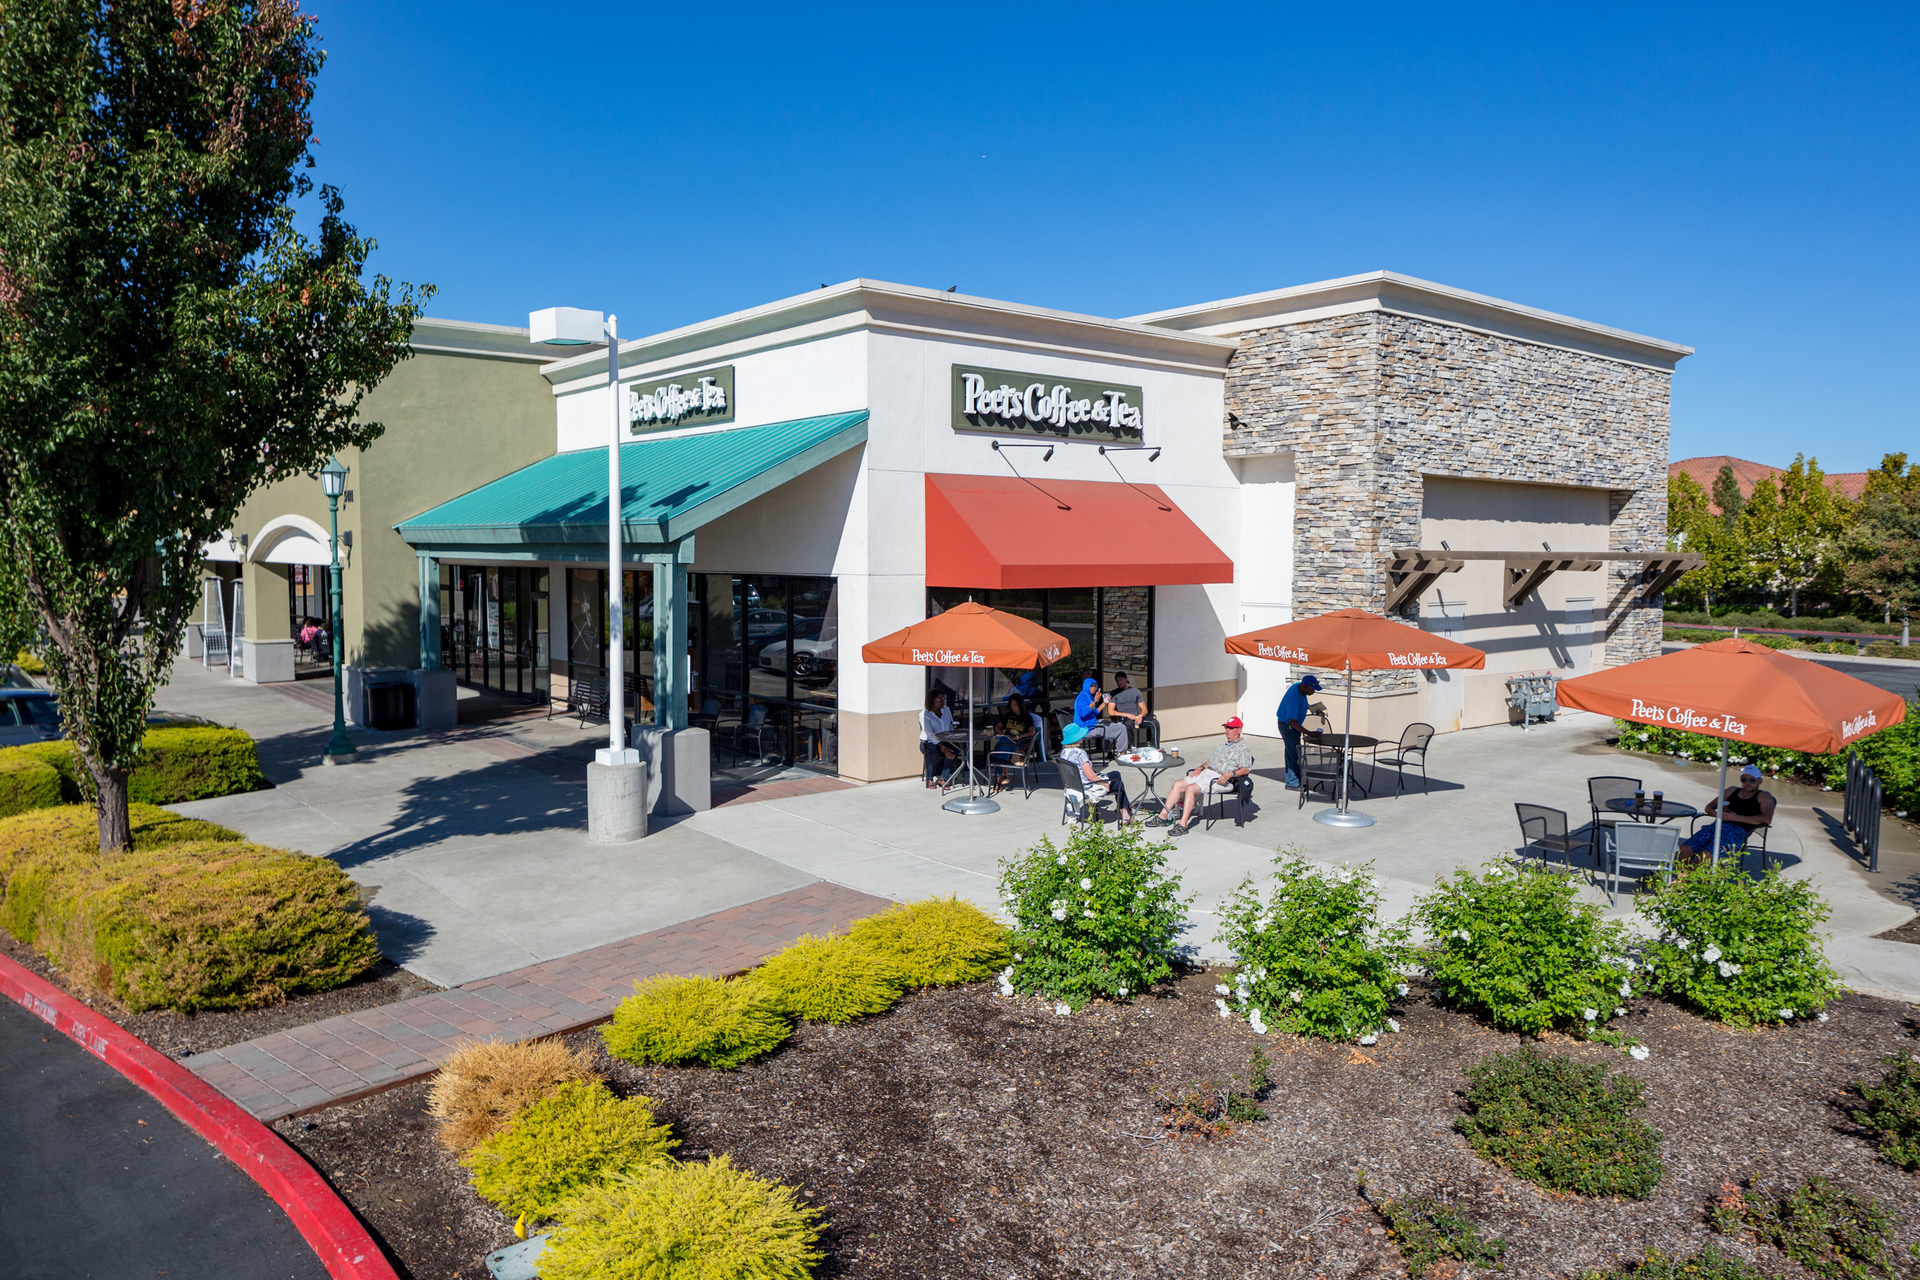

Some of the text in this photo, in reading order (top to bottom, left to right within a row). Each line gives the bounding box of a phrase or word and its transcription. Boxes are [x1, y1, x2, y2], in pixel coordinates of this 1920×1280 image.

[654, 384, 692, 419] Coffee
[698, 377, 726, 410] Tea
[1024, 383, 1091, 427] Coffee
[1091, 400, 1110, 421] &
[1103, 390, 1142, 429] Tea
[935, 650, 961, 664] Coffee
[962, 654, 970, 662] &
[968, 650, 985, 664] Tea
[1274, 645, 1291, 660] Coffee
[1292, 651, 1298, 659] &
[1297, 647, 1308, 662] Tea
[1408, 652, 1428, 667] Coffee
[1429, 656, 1435, 664] &
[1432, 652, 1447, 665] Tea
[1667, 707, 1707, 728] Coffee
[1709, 718, 1723, 729] &
[1721, 714, 1746, 735] Tea
[23, 991, 33, 1009] NO
[71, 1021, 88, 1046] FIRE
[88, 1032, 109, 1060] LANE
